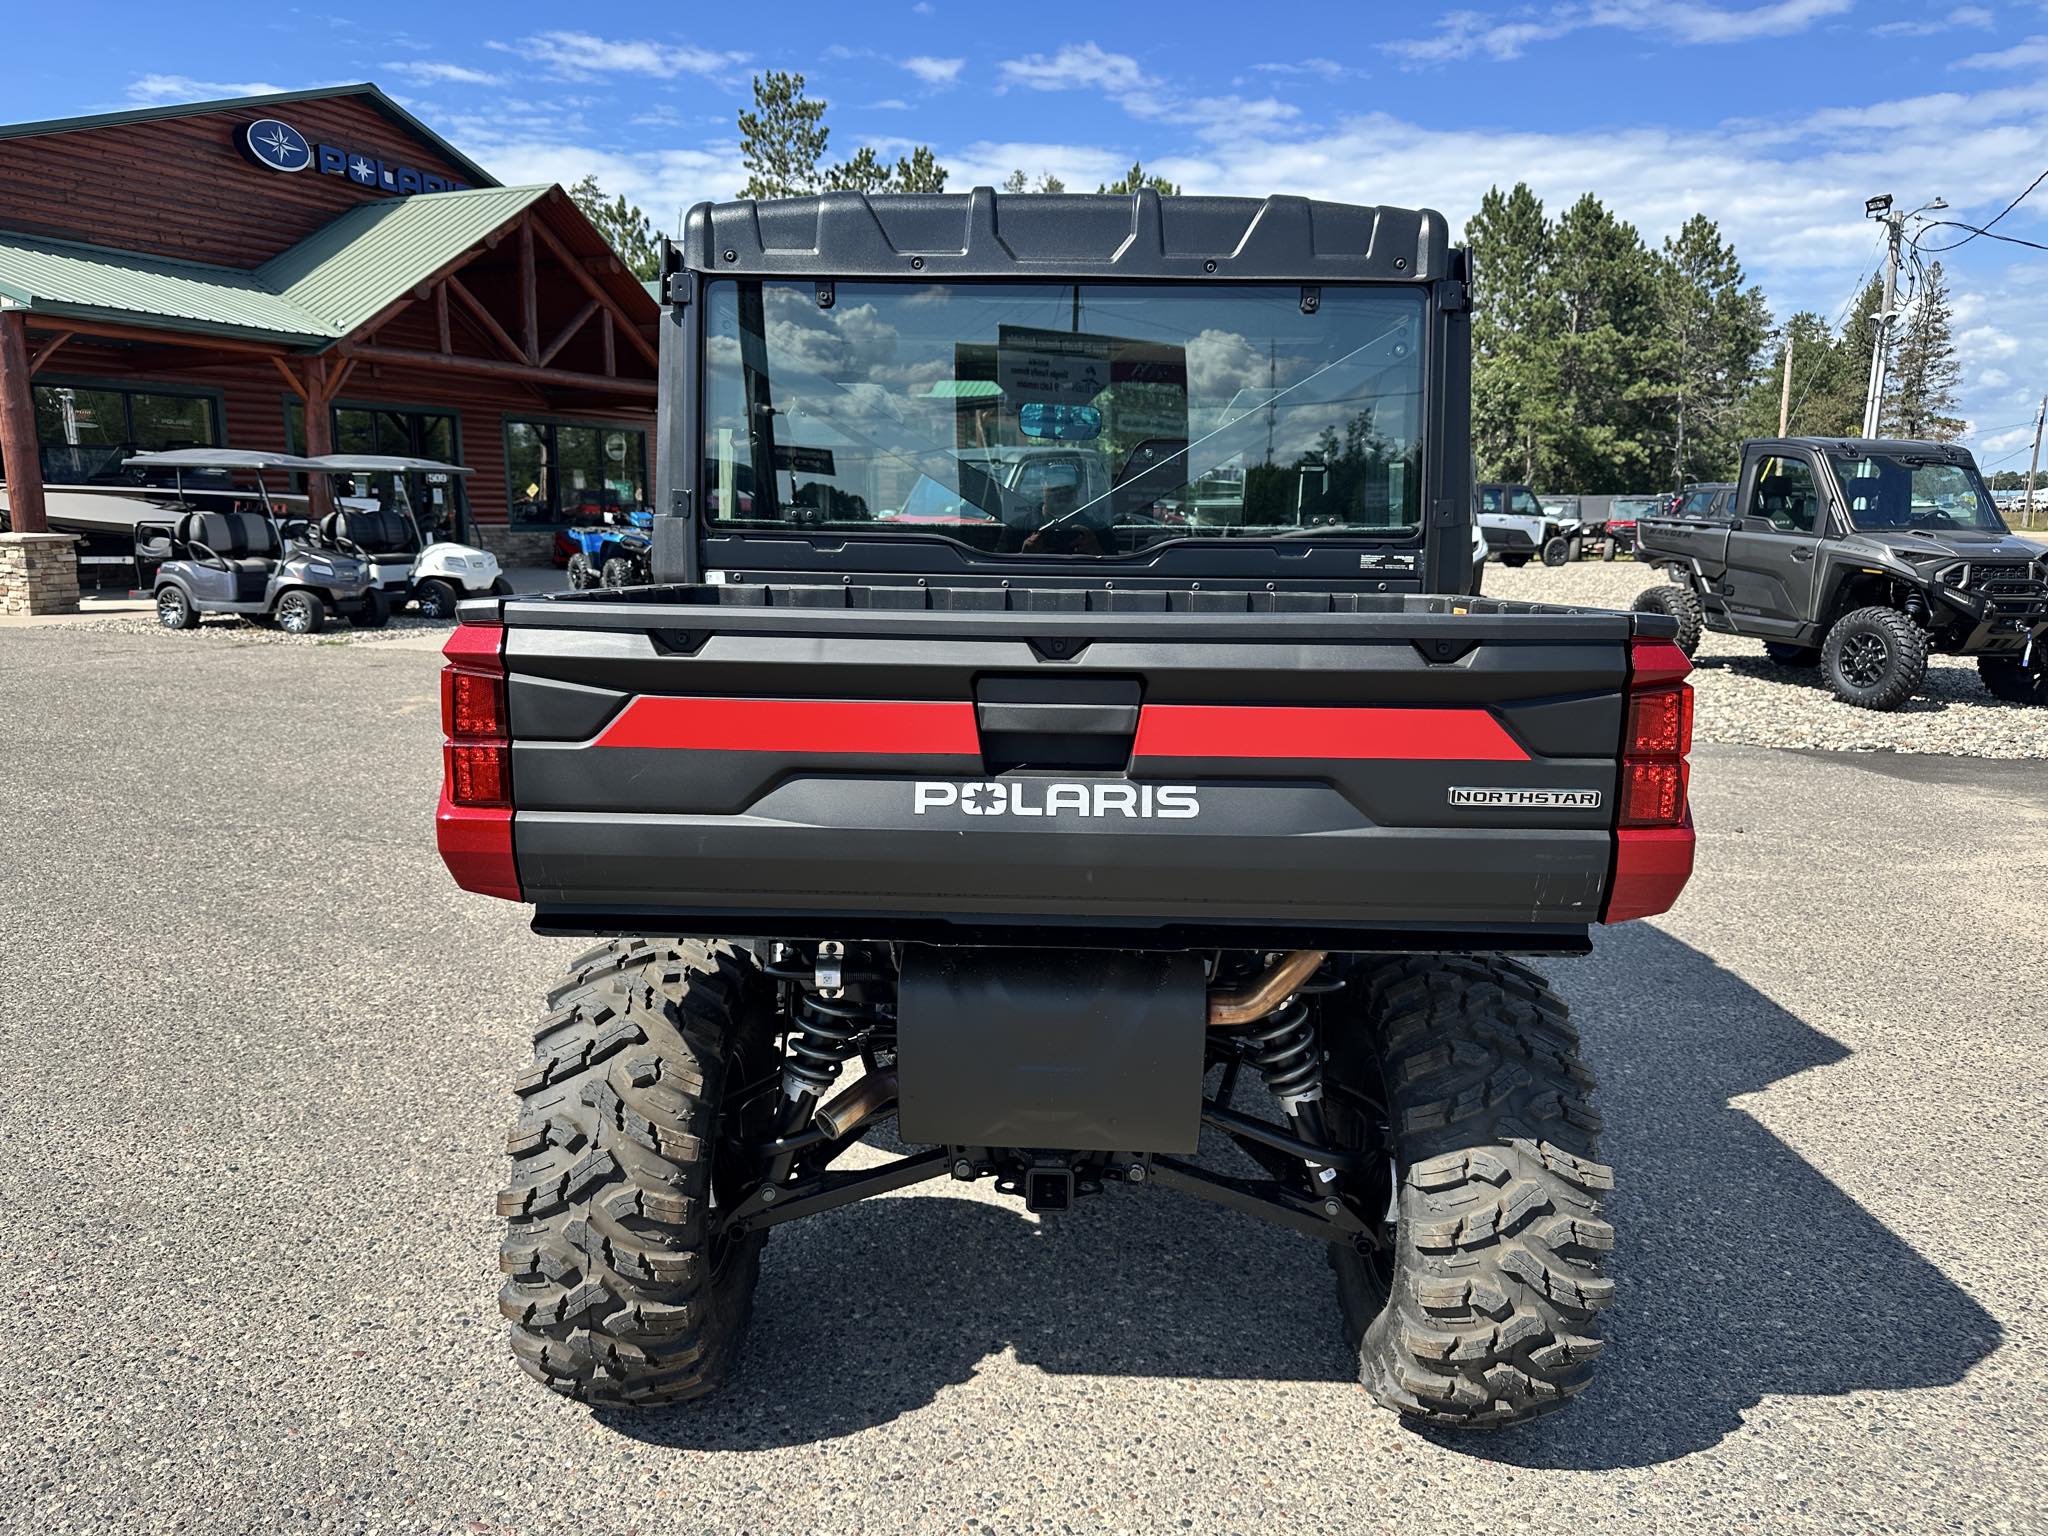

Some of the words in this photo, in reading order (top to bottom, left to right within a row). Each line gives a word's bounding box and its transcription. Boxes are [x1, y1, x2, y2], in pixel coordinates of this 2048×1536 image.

[315, 144, 474, 194] POLAR
[1649, 529, 1692, 539] RANGER
[914, 782, 1200, 818] POLARIS
[1457, 791, 1595, 804] NORTHSTAR
